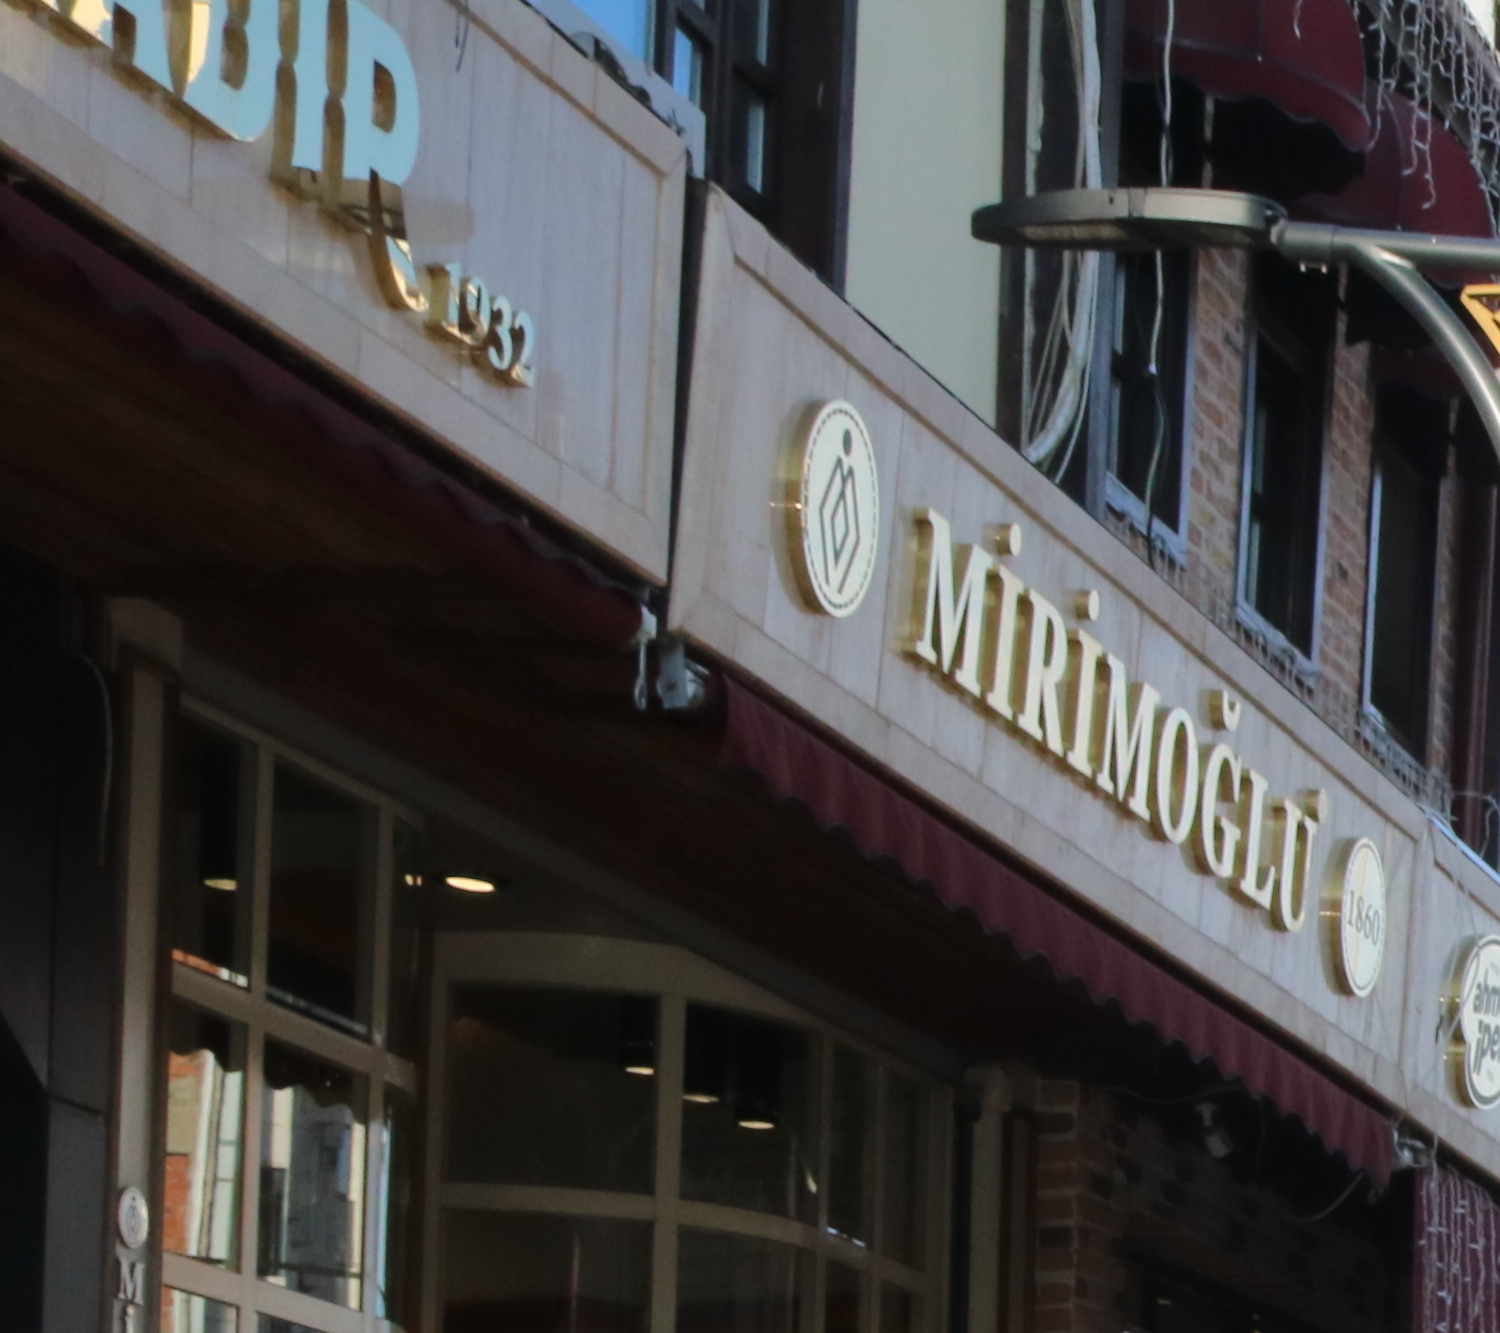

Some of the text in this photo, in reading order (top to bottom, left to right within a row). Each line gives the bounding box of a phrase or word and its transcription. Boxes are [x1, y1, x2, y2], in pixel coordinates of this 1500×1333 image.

[440, 262, 536, 389] 1932
[914, 506, 1322, 934] MİRİMOĞLU
[1346, 889, 1381, 947] 1860
